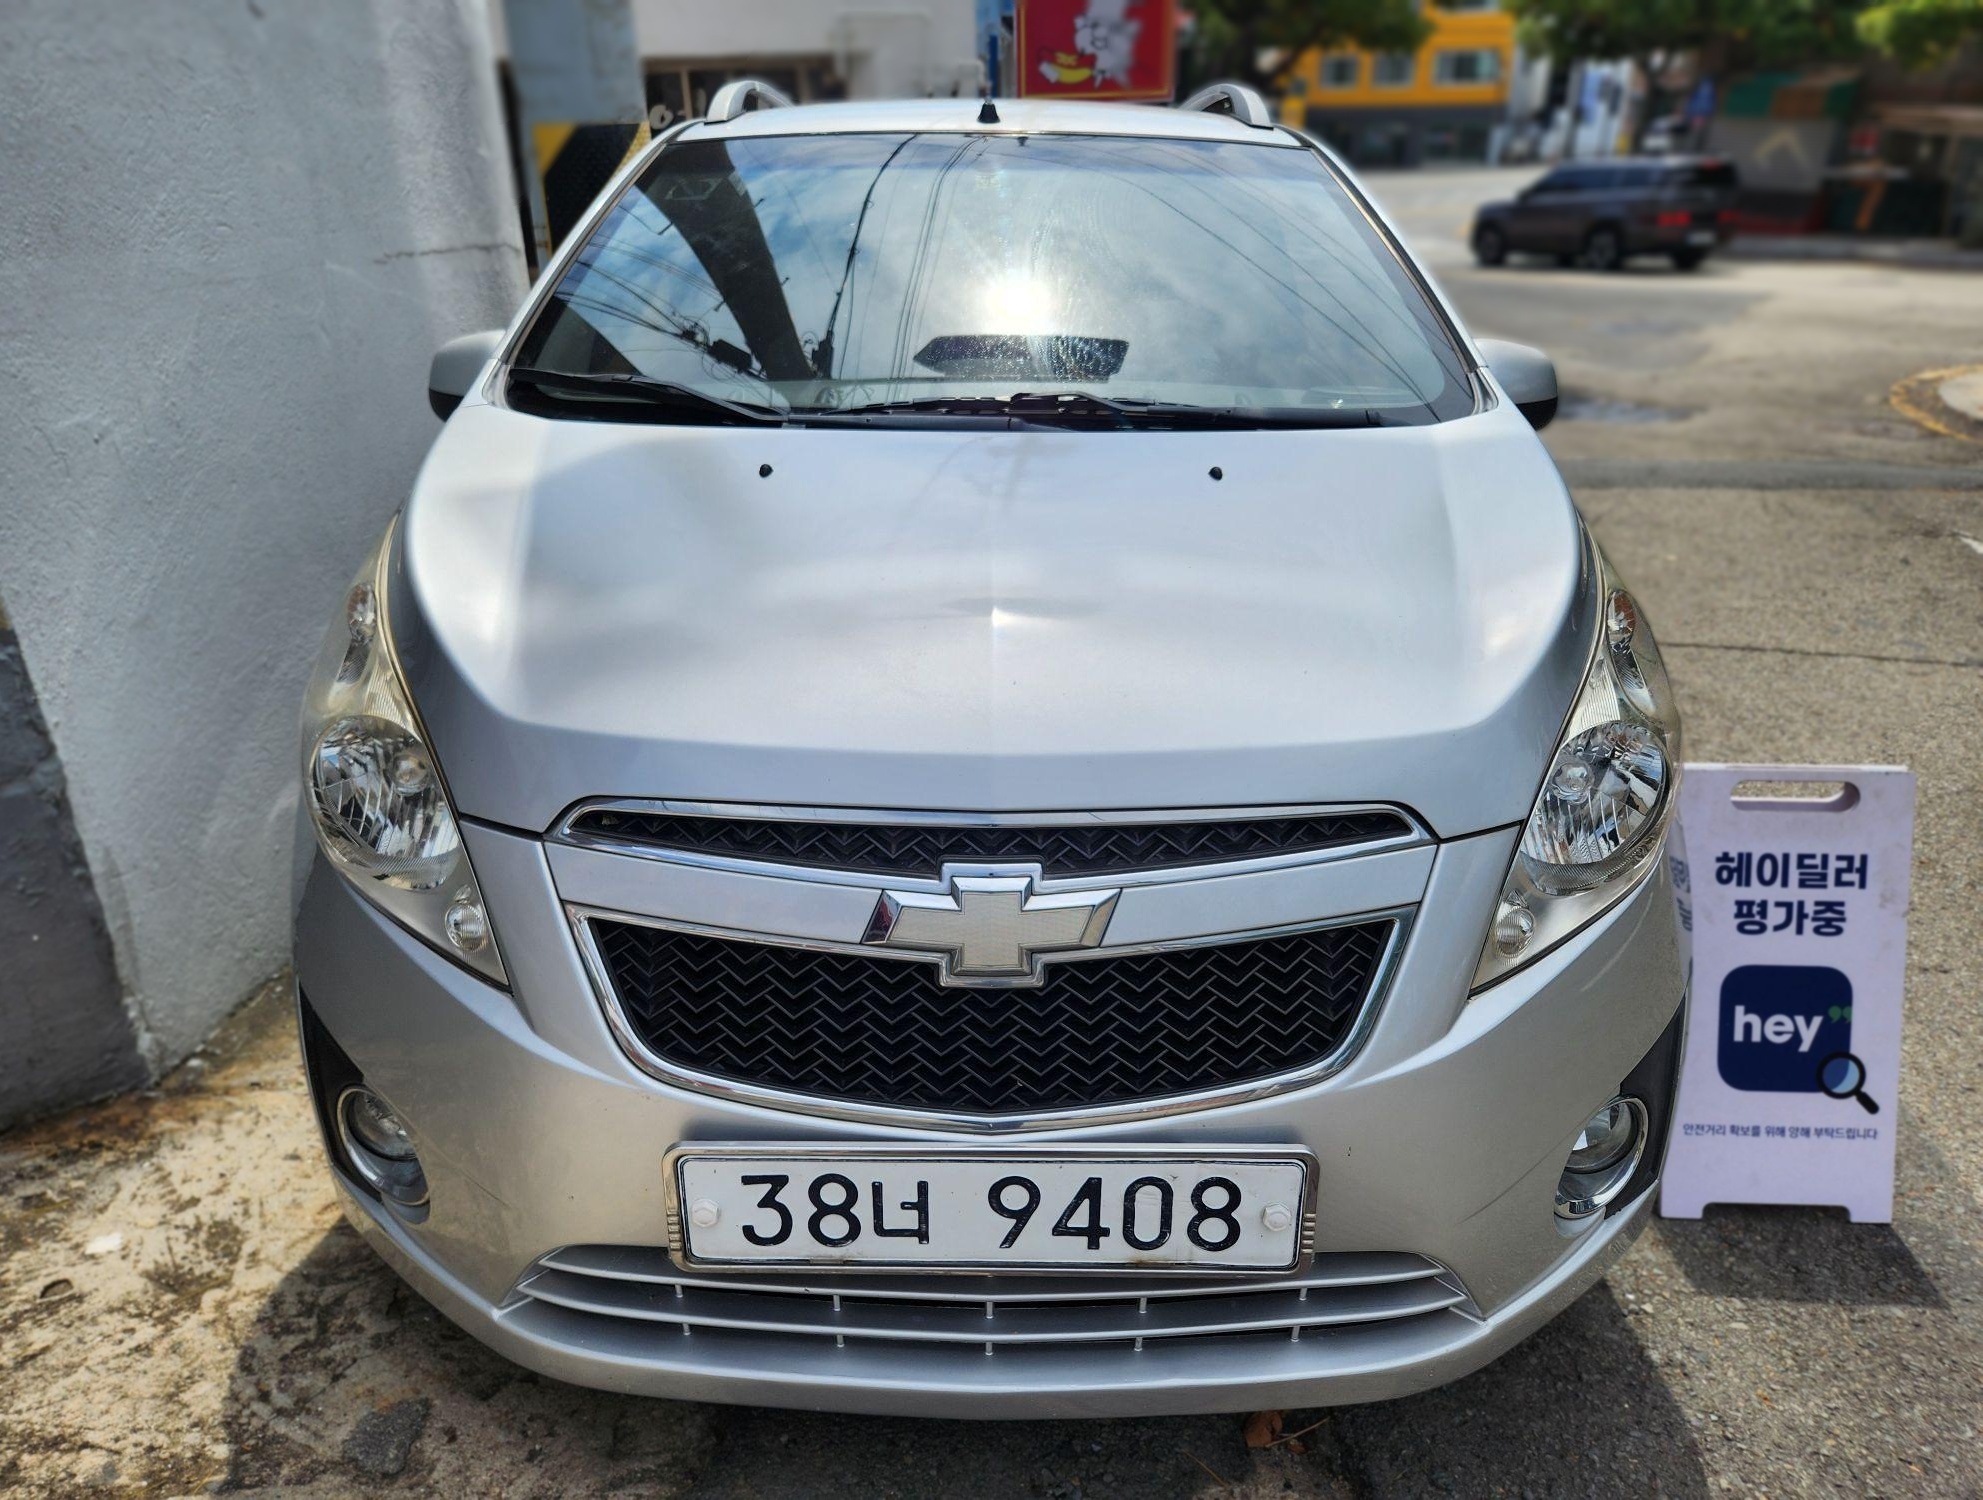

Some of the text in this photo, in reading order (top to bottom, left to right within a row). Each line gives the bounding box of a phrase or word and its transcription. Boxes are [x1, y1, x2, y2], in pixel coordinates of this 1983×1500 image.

[1714, 851, 1869, 891] 헤이딜러
[1733, 899, 1847, 938] 평가중
[1733, 1005, 1823, 1053] hey
[1682, 1123, 1878, 1140] 안전거리 확보를 위해 양해 부탁드립니다
[740, 1173, 1242, 1252] 38너 9408
